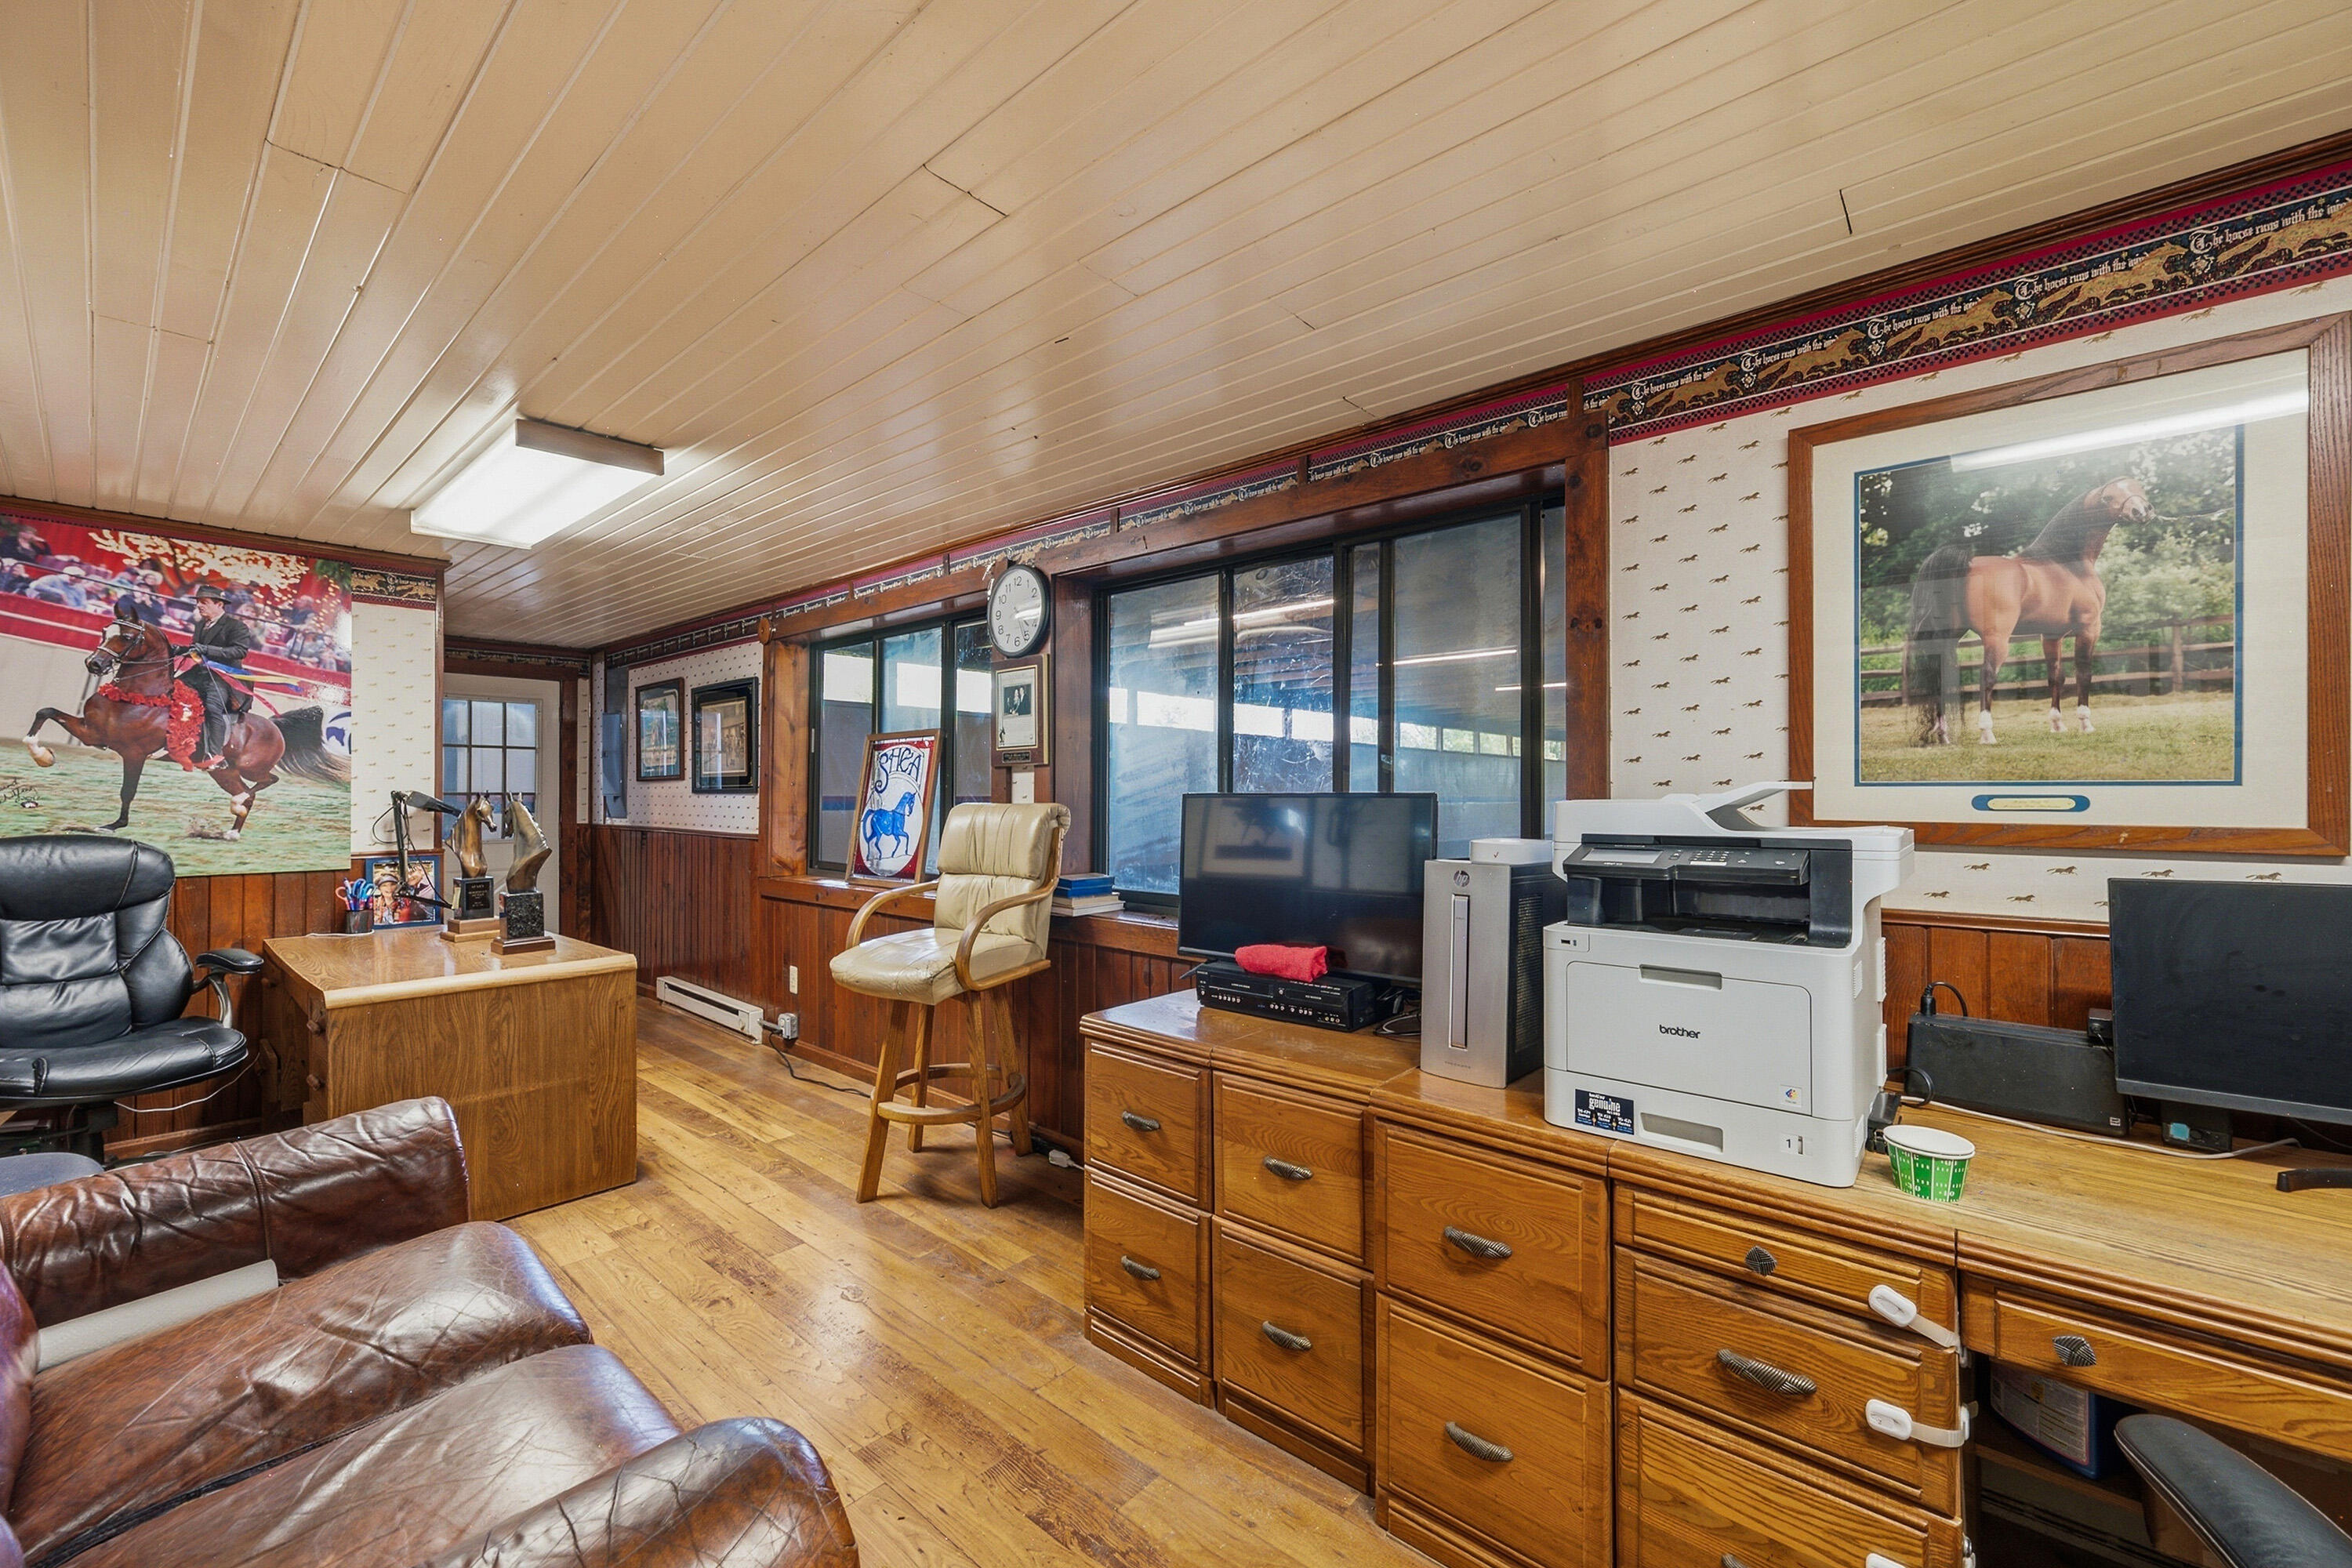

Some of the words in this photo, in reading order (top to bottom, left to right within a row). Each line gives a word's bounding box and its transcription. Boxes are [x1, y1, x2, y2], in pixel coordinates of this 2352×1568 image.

[2189, 226, 2223, 254] The
[2225, 228, 2253, 244] horse
[2255, 221, 2279, 234] runs
[2281, 208, 2305, 227] with
[2307, 203, 2324, 220] the
[2013, 275, 2042, 300] The
[2070, 271, 2089, 284] runs
[2091, 260, 2111, 278] with
[1866, 315, 1891, 339] The
[1014, 576, 1022, 586] 12
[1005, 583, 1011, 593] 11
[1031, 588, 1037, 597] 2
[999, 594, 1007, 604] 10
[996, 610, 1001, 620] 9
[998, 625, 1004, 634] 8
[1006, 633, 1011, 644] 7
[1024, 630, 1030, 641] 5
[1014, 637, 1021, 647] 6
[1454, 870, 1470, 887] hp
[1659, 1024, 1700, 1039] brother
[1588, 1098, 1621, 1112] genuine
[1786, 1139, 1791, 1148] 1
